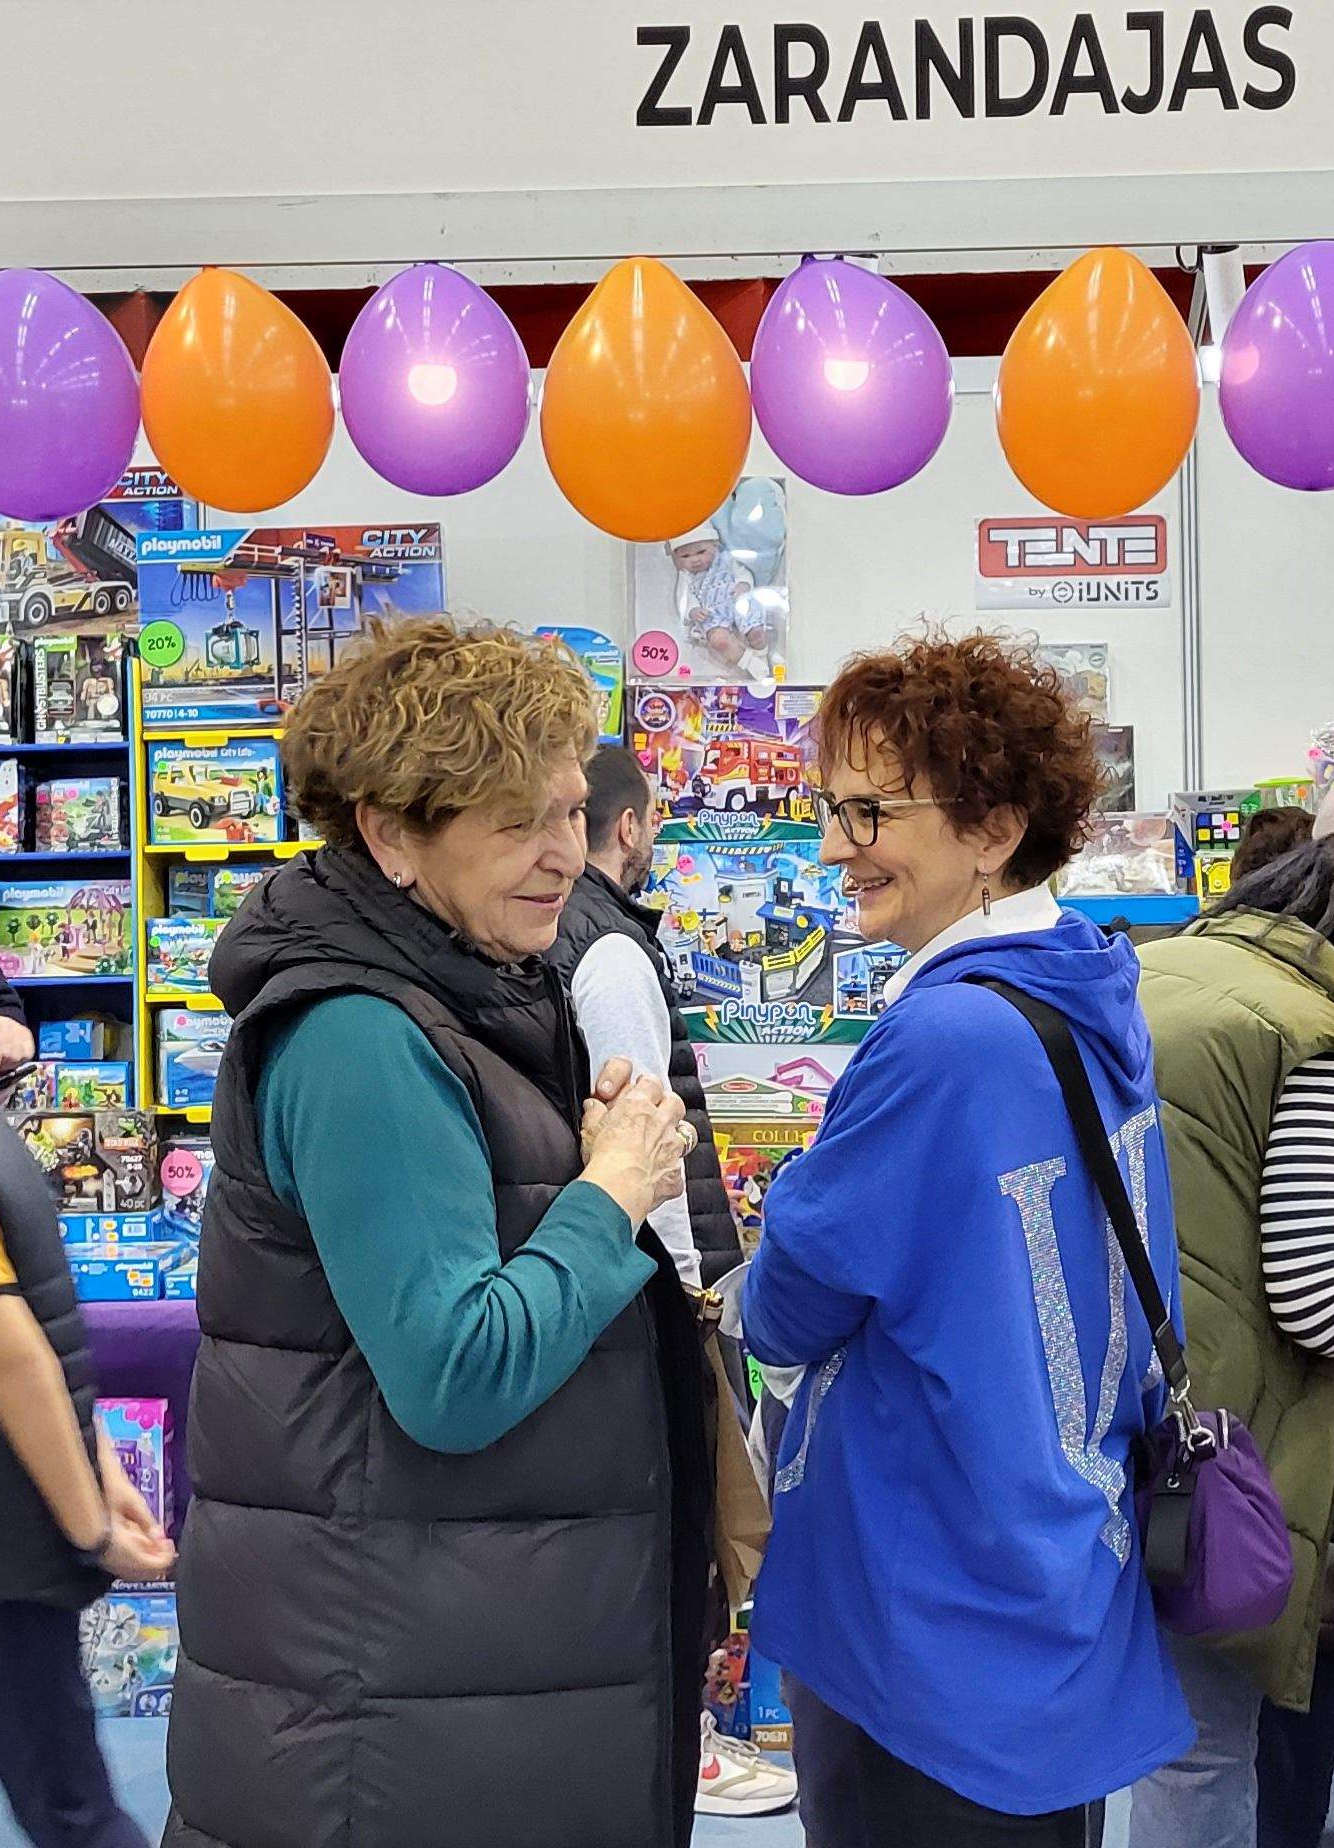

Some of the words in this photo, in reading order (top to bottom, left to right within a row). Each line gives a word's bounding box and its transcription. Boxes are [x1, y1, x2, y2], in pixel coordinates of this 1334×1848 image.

[635, 7, 1296, 127] ZARANDAJAS
[123, 486, 178, 497] ACTION
[141, 534, 222, 554] playmobil
[362, 528, 429, 546] CITY
[369, 545, 436, 558] ACTION
[988, 525, 1157, 568] TENTE
[1028, 587, 1046, 598] by
[147, 635, 177, 651] 20%
[640, 646, 669, 662] 50%
[178, 708, 199, 718] 4-10
[154, 747, 218, 761] playmobil
[3, 886, 66, 902] playmobil
[151, 924, 205, 938] playmobil
[722, 998, 817, 1024] Pinypon
[760, 1025, 815, 1037] ACTION
[167, 1166, 196, 1179] 50%
[765, 1708, 780, 1720] PC
